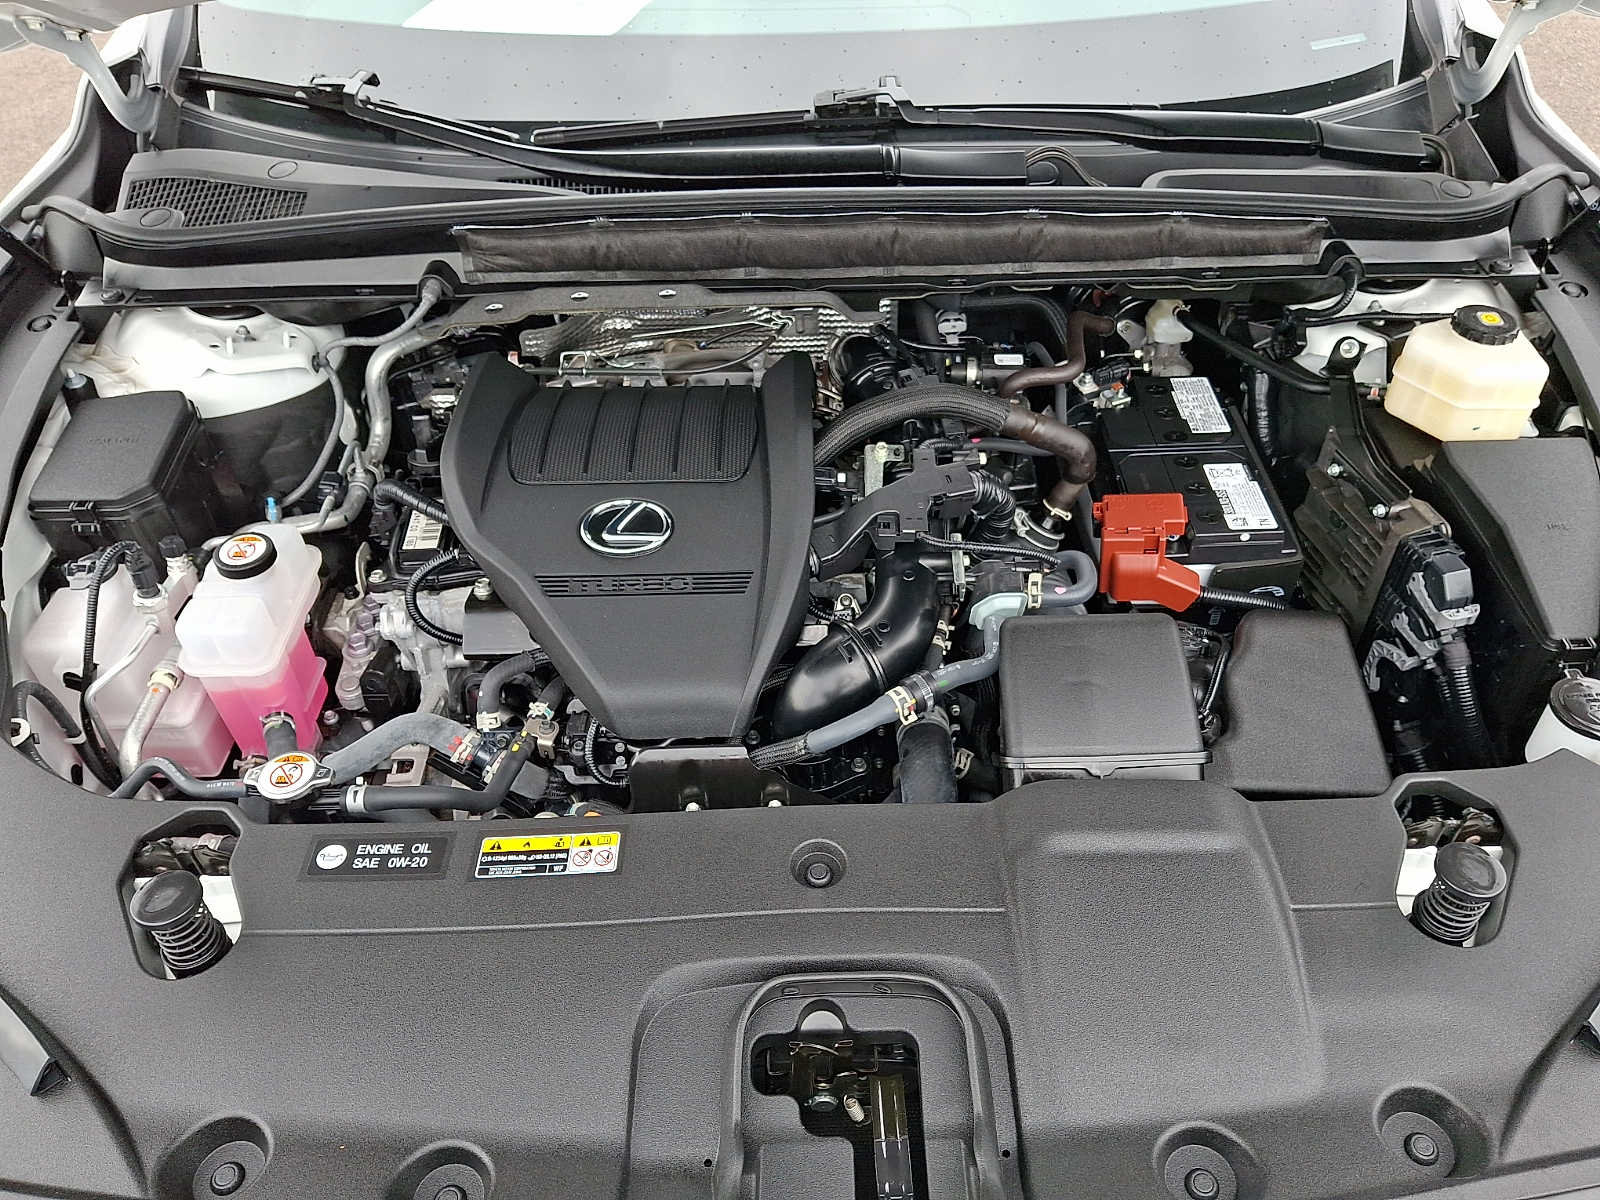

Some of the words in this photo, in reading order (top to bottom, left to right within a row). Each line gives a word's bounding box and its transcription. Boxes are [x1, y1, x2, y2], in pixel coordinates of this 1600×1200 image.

[568, 577, 692, 593] TURBO
[356, 843, 405, 855] ENGINE
[411, 842, 432, 854] OIL
[352, 857, 381, 869] SAE
[387, 856, 428, 868] 0W-20
